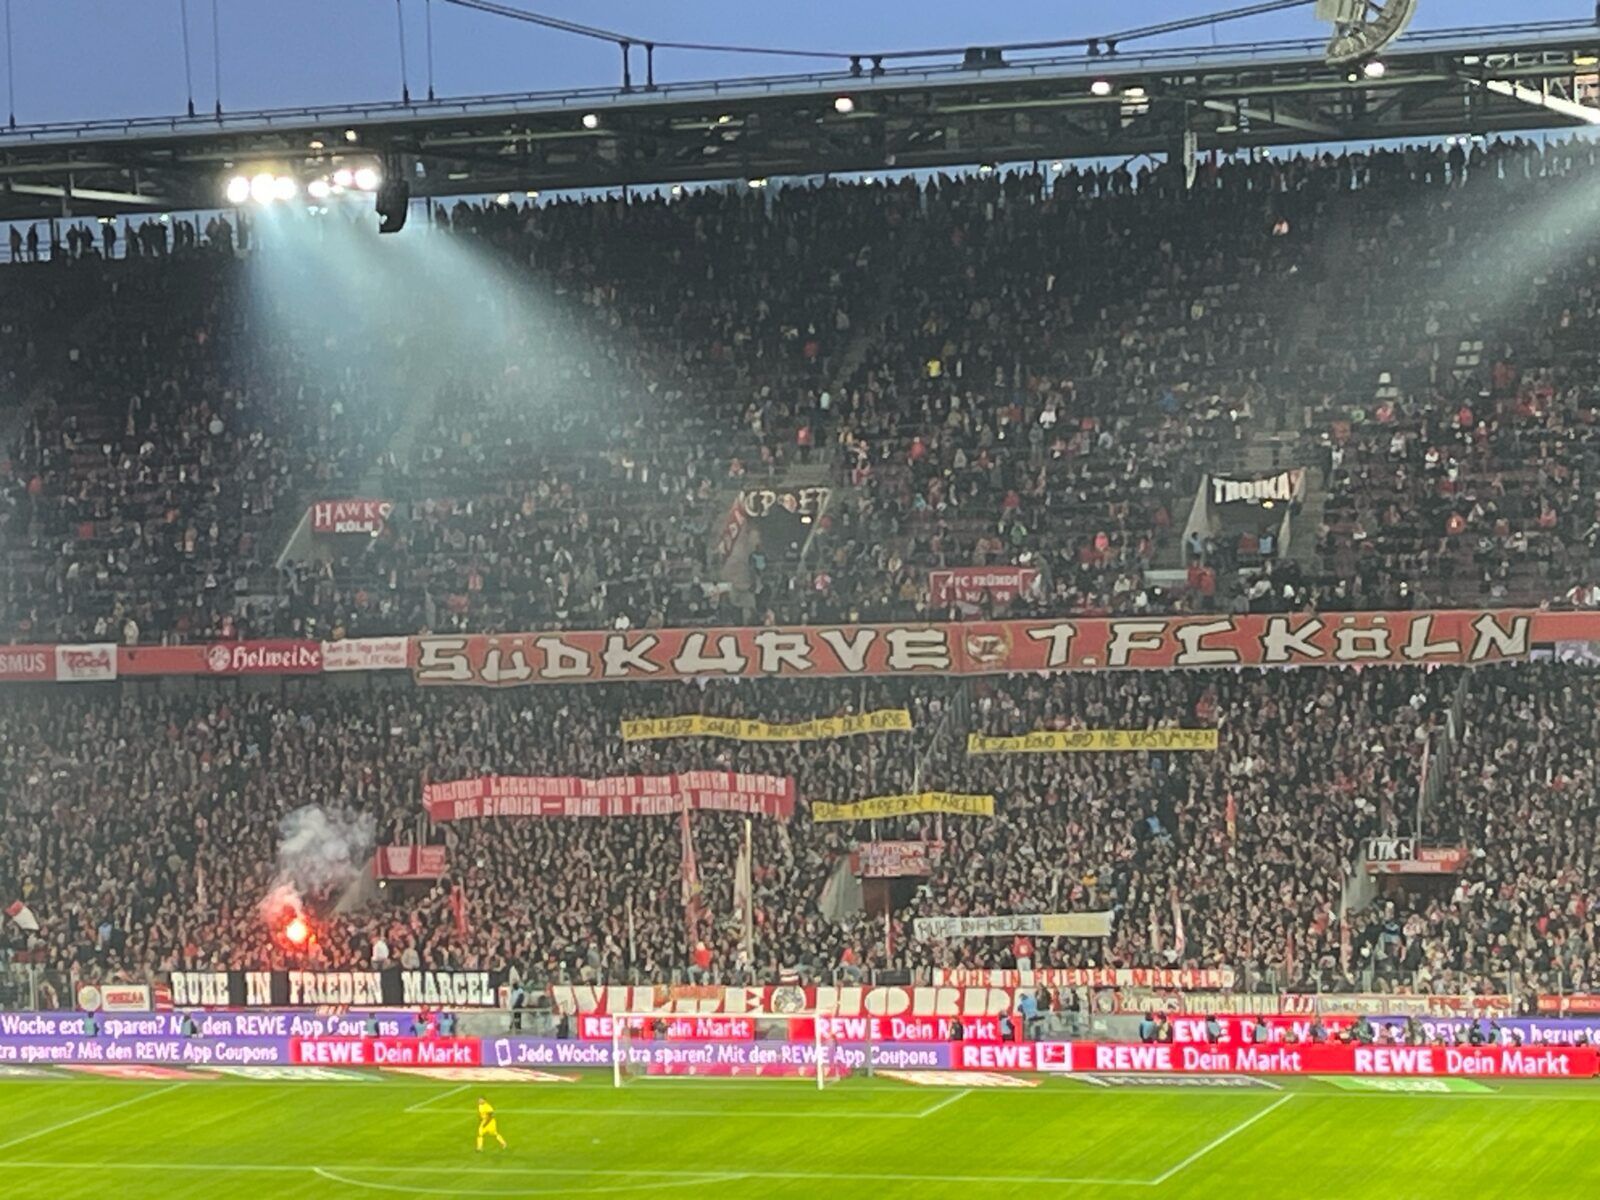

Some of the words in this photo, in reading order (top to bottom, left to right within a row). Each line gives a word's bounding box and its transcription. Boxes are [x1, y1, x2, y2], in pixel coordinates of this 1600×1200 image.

[232, 644, 320, 671] Holweide
[416, 628, 950, 682] SÜDKURVE
[1261, 612, 1530, 664] KÖLN
[172, 972, 229, 1005] RUHE
[245, 972, 272, 1005] IN
[288, 971, 384, 1004] FRIEDEN
[401, 971, 495, 1004] MARCEL
[943, 968, 991, 986] RUHE
[1001, 968, 1021, 986] IN
[1033, 968, 1117, 987] FRIEDEN
[1, 1015, 56, 1035] Woche
[104, 1016, 166, 1039] sparen?
[203, 1016, 232, 1035] den
[236, 1016, 287, 1036] REWE
[290, 1017, 323, 1039] App
[327, 1016, 400, 1039] Coupns
[696, 1018, 750, 1037] Markt
[818, 1018, 881, 1039] REWE
[892, 1018, 932, 1039] Dein
[21, 1043, 75, 1062] sparen?
[78, 1042, 103, 1060] Mit
[106, 1042, 132, 1059] den
[136, 1042, 180, 1060] REWE
[183, 1043, 212, 1063] App
[215, 1042, 278, 1063] Coupons
[301, 1042, 364, 1063] REWE
[373, 1043, 412, 1063] Dein
[418, 1042, 471, 1063] Markt
[517, 1044, 554, 1063] Jede
[556, 1044, 609, 1063] Woche
[654, 1045, 714, 1065] sparen?
[717, 1045, 746, 1063] Mit
[749, 1045, 777, 1063] den
[782, 1046, 830, 1064] REWE
[834, 1046, 866, 1067] App
[870, 1046, 938, 1067] Coupons
[963, 1046, 1032, 1067] REWE
[1096, 1046, 1172, 1069] REWE
[1183, 1047, 1230, 1070] Dein
[1235, 1047, 1301, 1071] Markt
[1354, 1049, 1434, 1072] REWE
[1446, 1051, 1495, 1073] Dein
[1501, 1051, 1569, 1074] Markt
